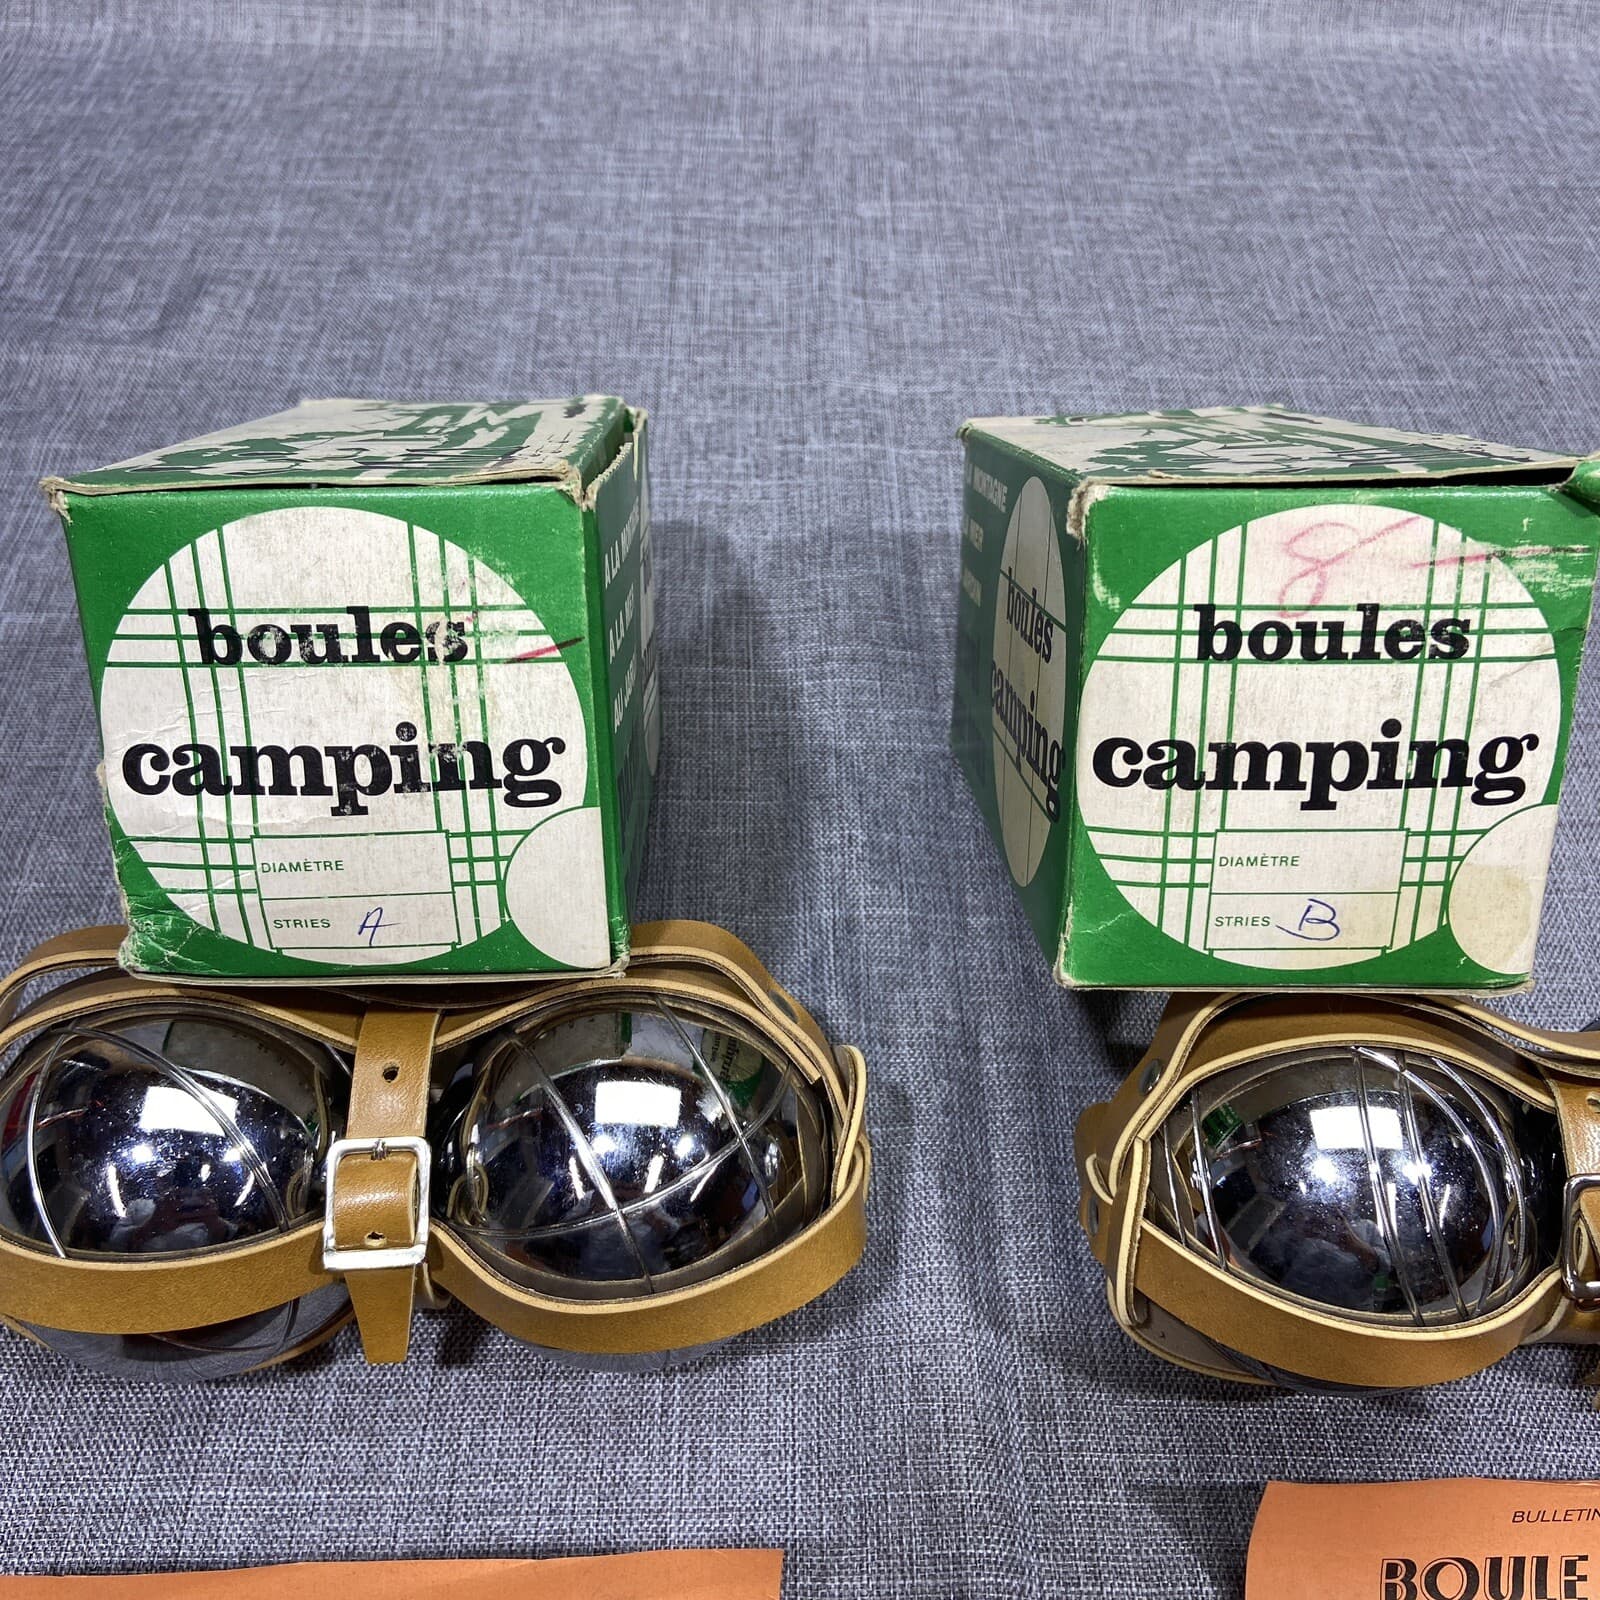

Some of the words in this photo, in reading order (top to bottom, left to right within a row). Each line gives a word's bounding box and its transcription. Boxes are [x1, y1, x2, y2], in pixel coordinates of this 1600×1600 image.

[604, 553, 611, 589] A
[610, 539, 621, 581] LA
[188, 606, 468, 666] boules
[609, 628, 616, 665] A
[615, 610, 625, 651] LA
[1006, 566, 1053, 664] boules
[1193, 603, 1472, 661] boules
[991, 659, 1066, 824] camping
[1092, 718, 1539, 811] camping
[122, 722, 566, 817] camping
[261, 858, 345, 873] DIAMÈTRE
[1218, 852, 1300, 867] DIAMÈTRE
[273, 918, 332, 929] STRIES
[357, 906, 402, 947] A
[1214, 915, 1271, 927] STRIES
[1275, 898, 1340, 941] B
